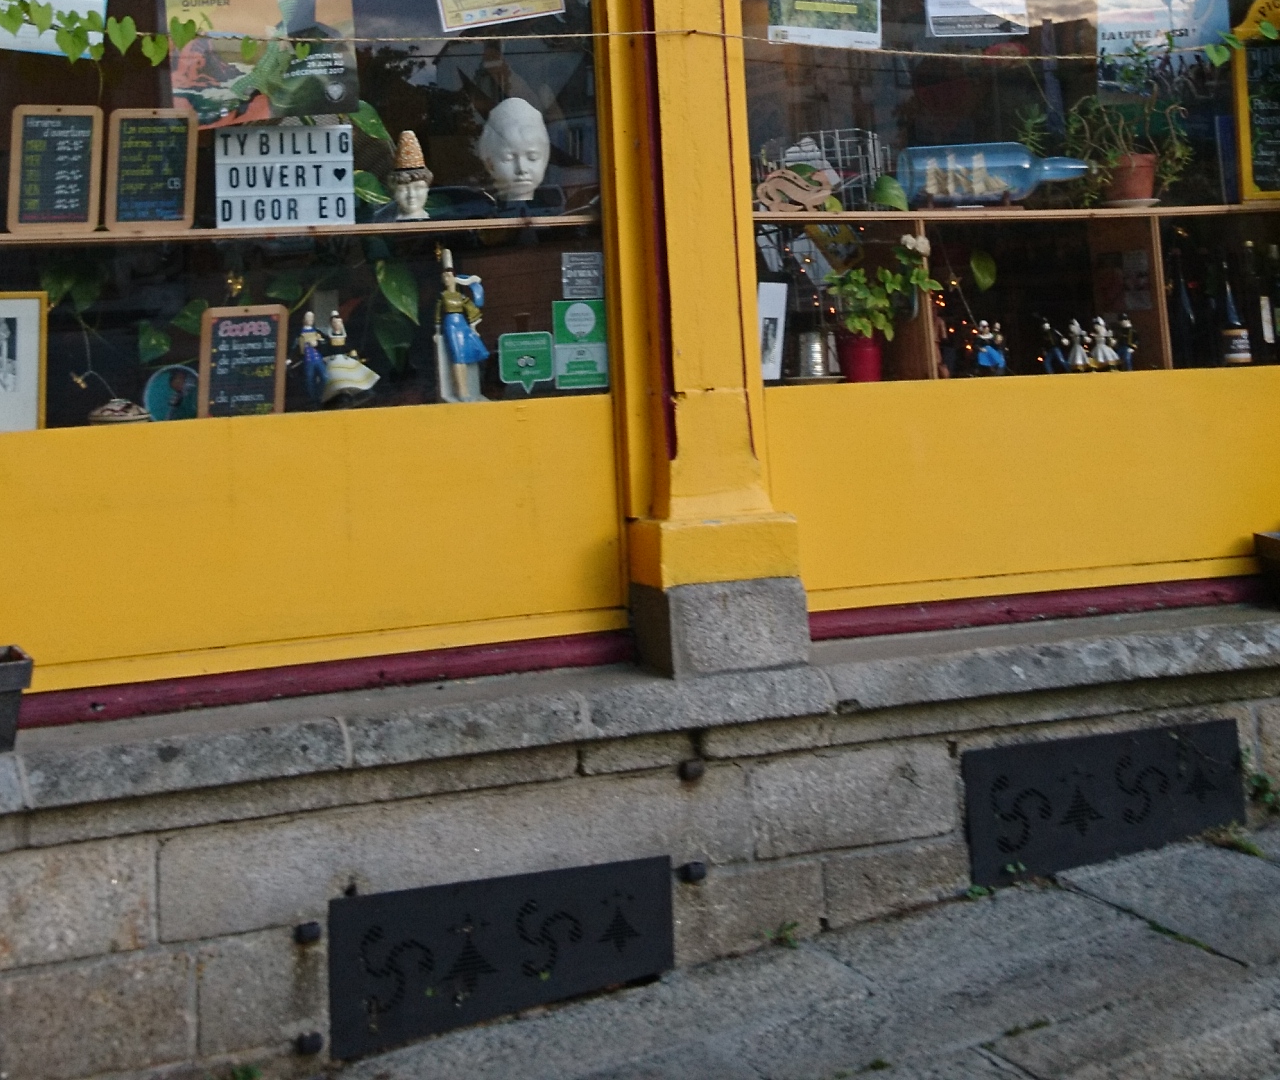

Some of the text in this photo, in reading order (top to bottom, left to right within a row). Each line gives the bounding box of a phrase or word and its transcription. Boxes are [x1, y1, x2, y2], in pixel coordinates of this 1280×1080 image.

[1101, 31, 1116, 41] LA
[1118, 30, 1152, 40] LUTTE
[1154, 28, 1189, 39] ASSI
[333, 52, 344, 60] DU
[220, 131, 350, 156] TY BILLIG
[229, 164, 323, 189] OUVERT
[221, 196, 347, 222] DIGOR EO
